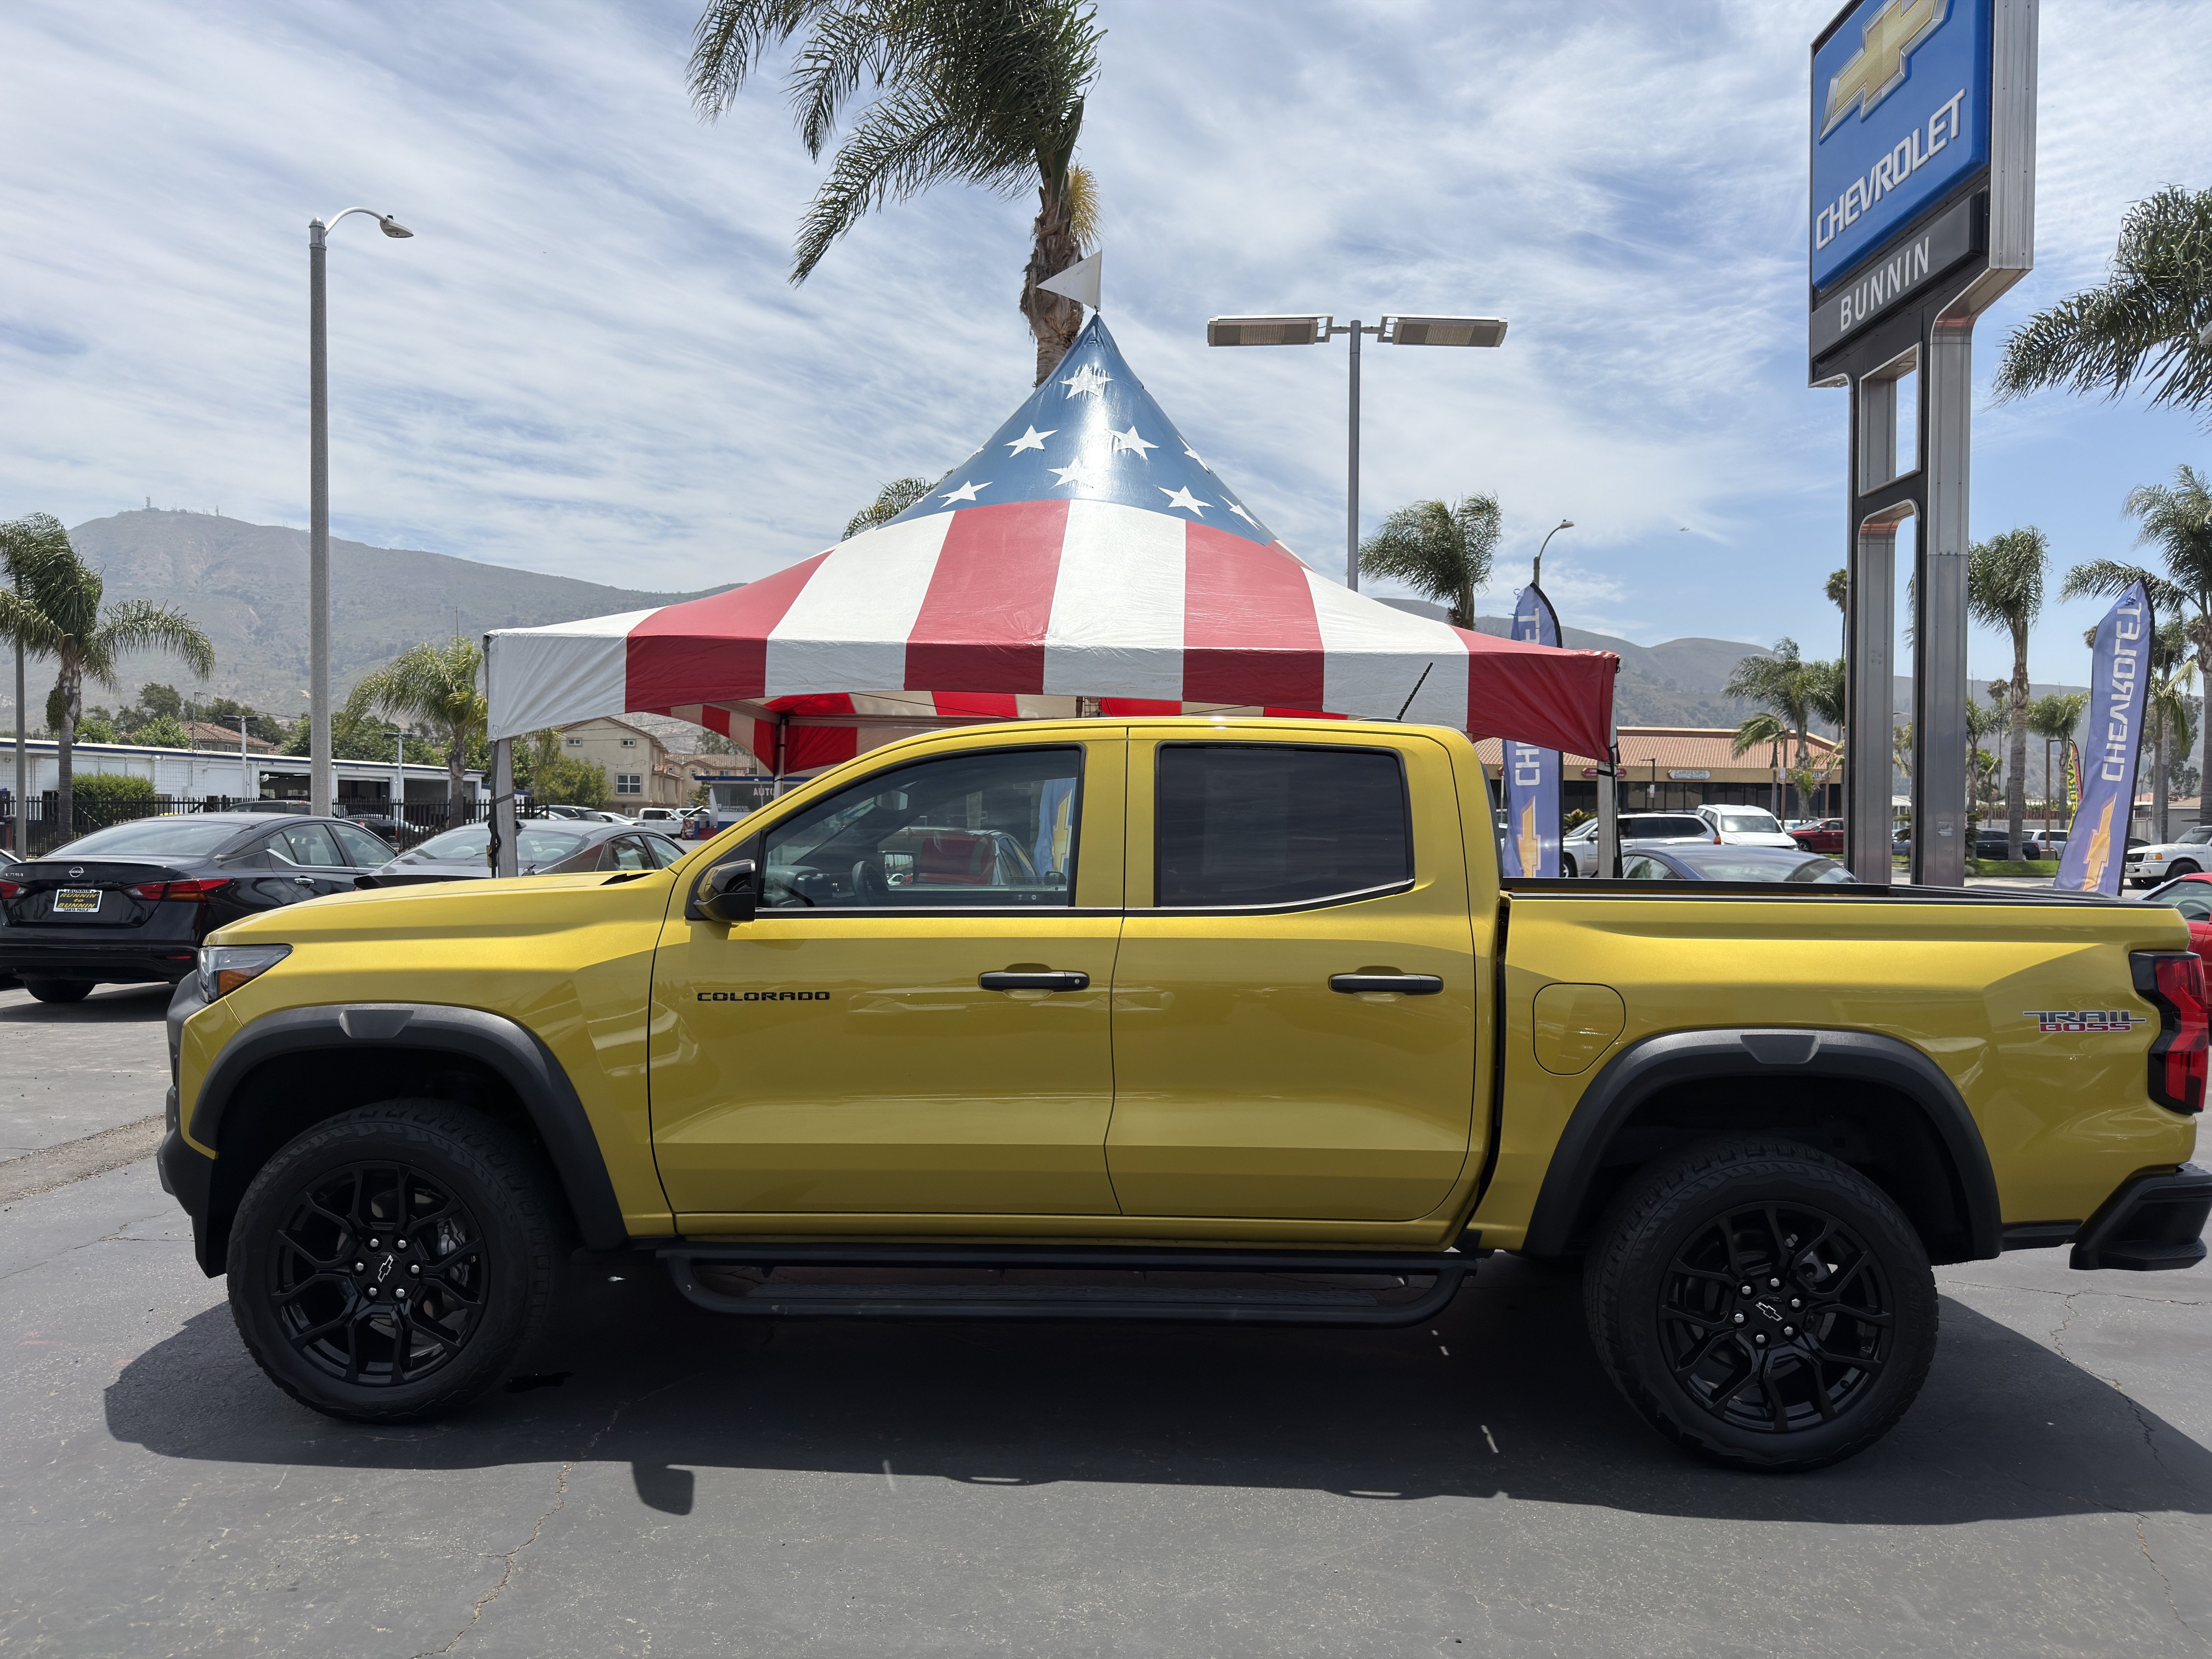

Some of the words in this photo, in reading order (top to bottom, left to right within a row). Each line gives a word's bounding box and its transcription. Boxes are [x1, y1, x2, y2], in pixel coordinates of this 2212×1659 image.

[1815, 88, 1966, 250] CHEVROLET
[1840, 236, 1929, 332] BUNNIN
[697, 991, 830, 1001] COLORADO
[2023, 1011, 2146, 1023] TRAIL
[2040, 1022, 2131, 1032] BOSS
